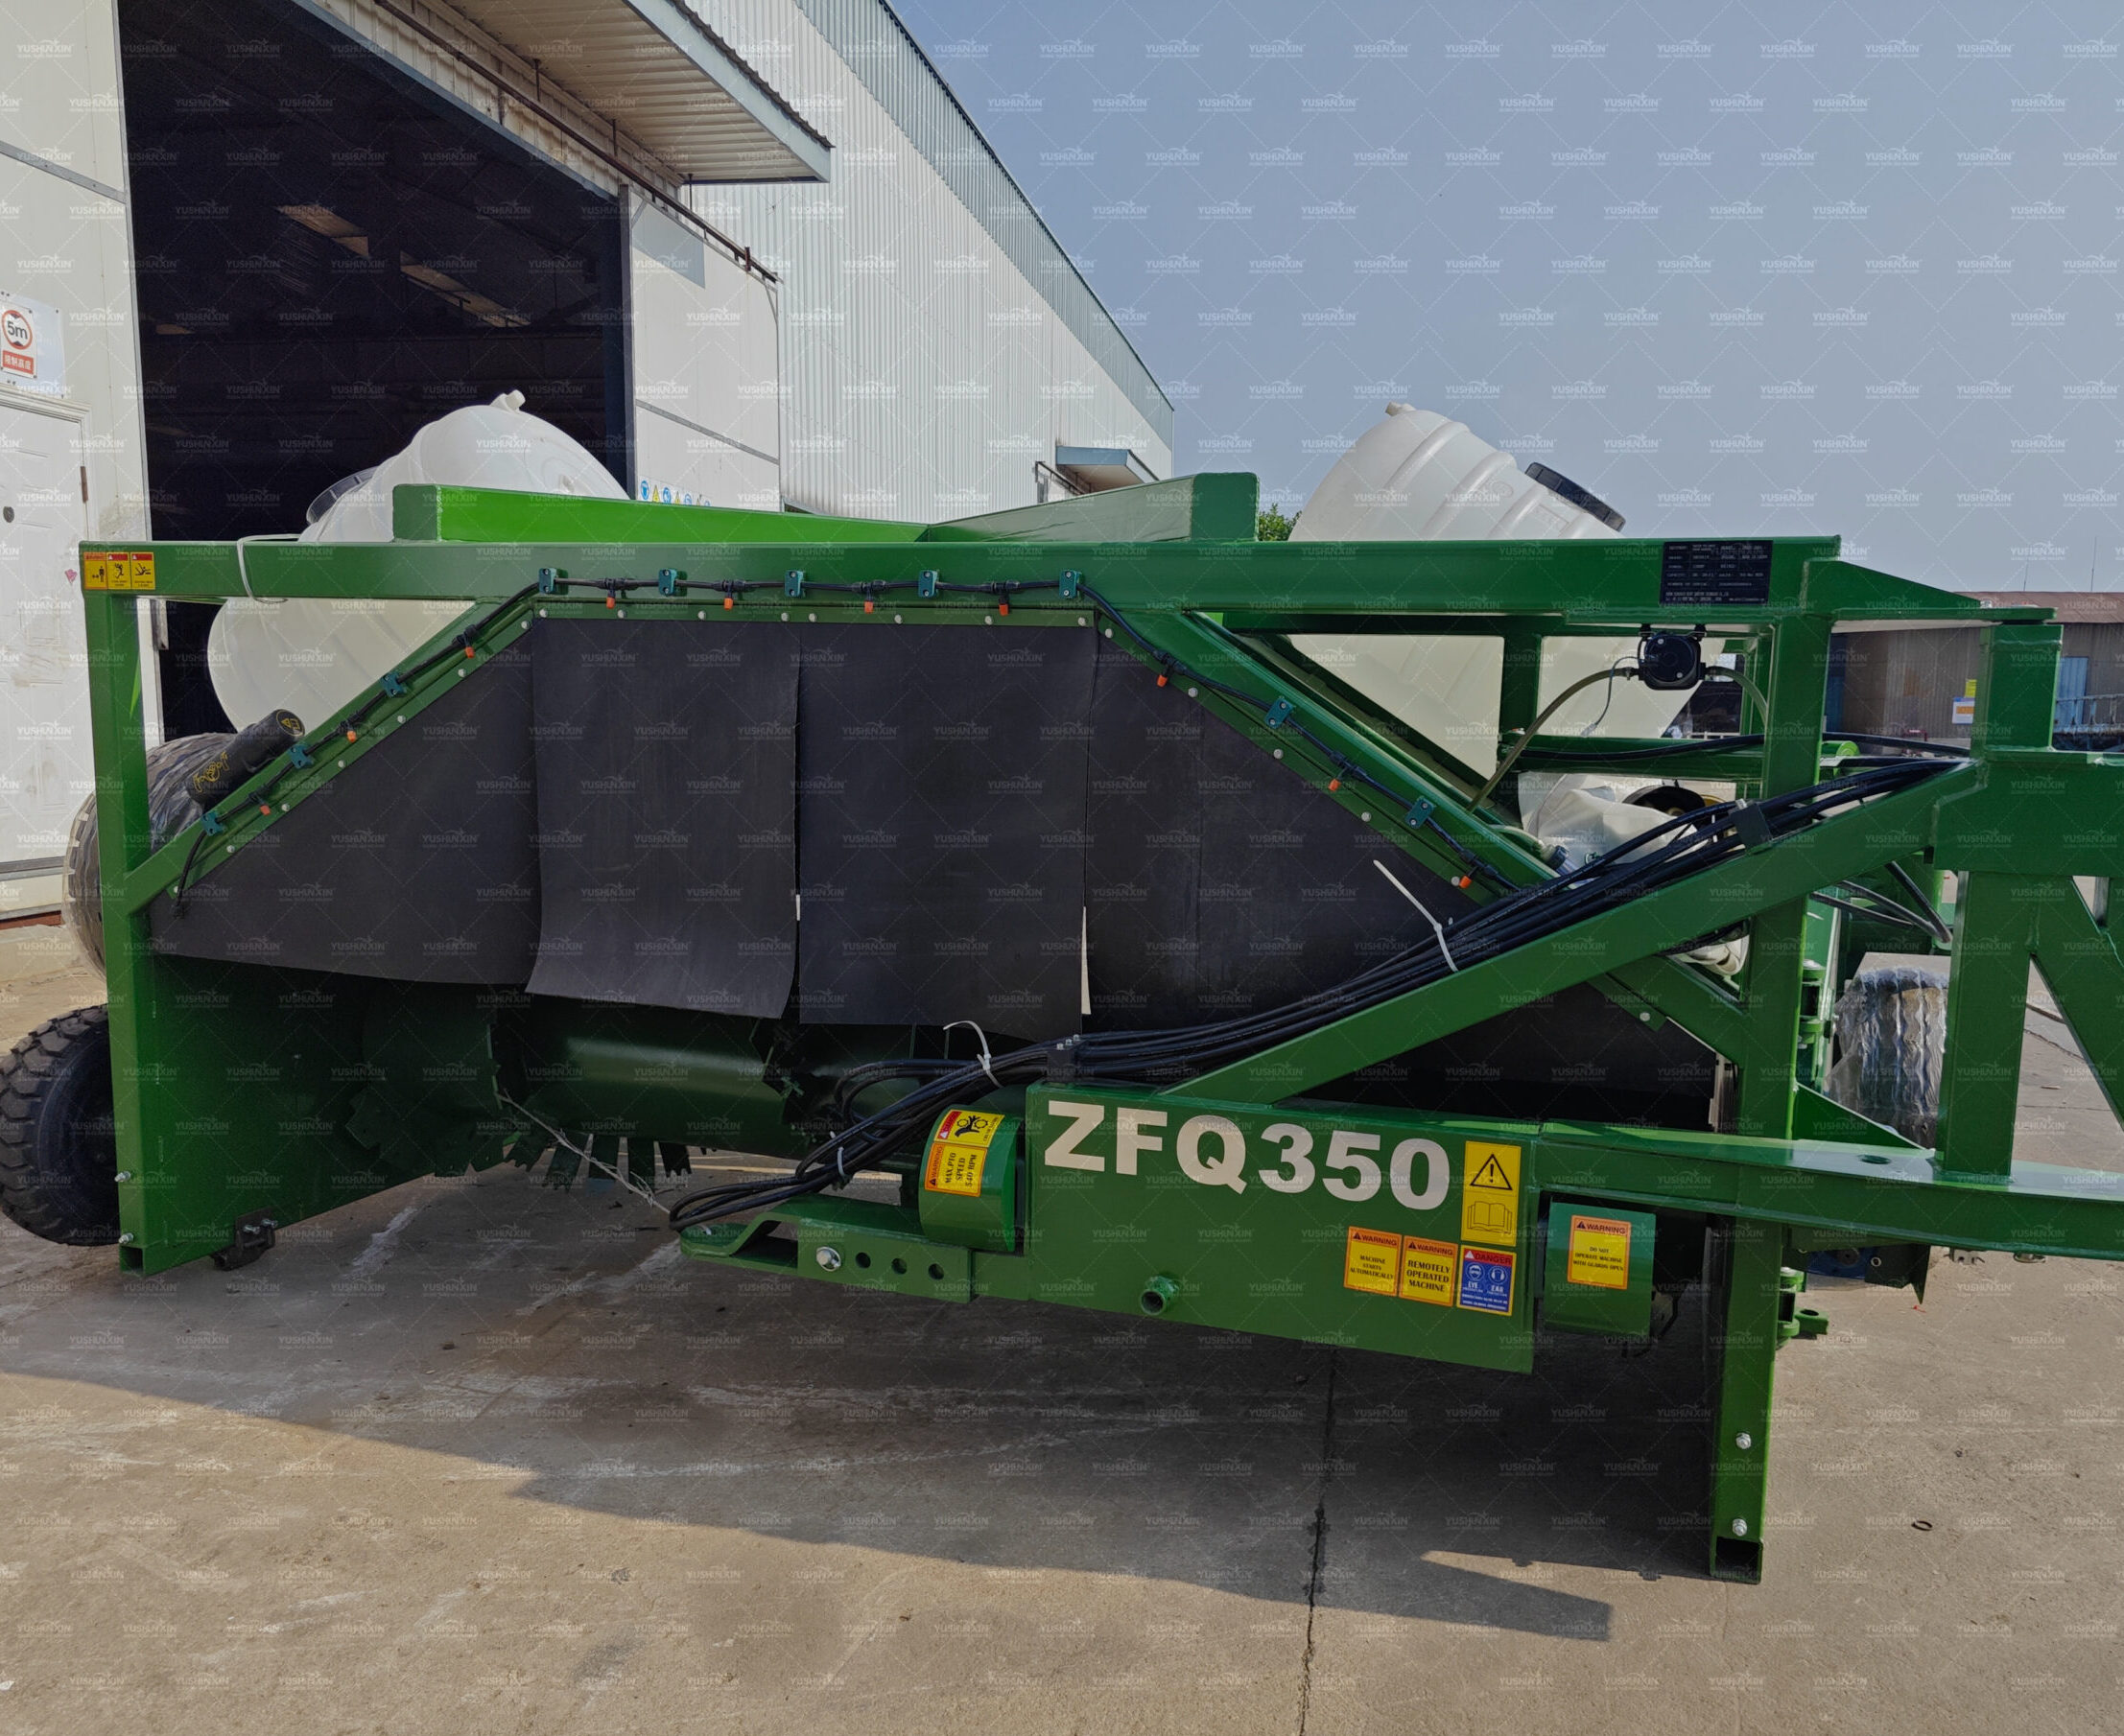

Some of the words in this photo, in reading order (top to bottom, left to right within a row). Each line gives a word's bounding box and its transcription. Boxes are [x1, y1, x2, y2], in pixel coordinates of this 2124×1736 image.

[8, 320, 28, 340] 5m
[1045, 1100, 1451, 1210] ZFQ350
[1588, 1224, 1626, 1234] WARNING
[1362, 1234, 1398, 1246] WARNING
[1417, 1244, 1453, 1255] WARNING
[1475, 1253, 1512, 1265] DANGER
[1407, 1259, 1451, 1274] REMOTELY
[1406, 1269, 1450, 1283] OPERATED
[1408, 1279, 1445, 1293] MACHINE
